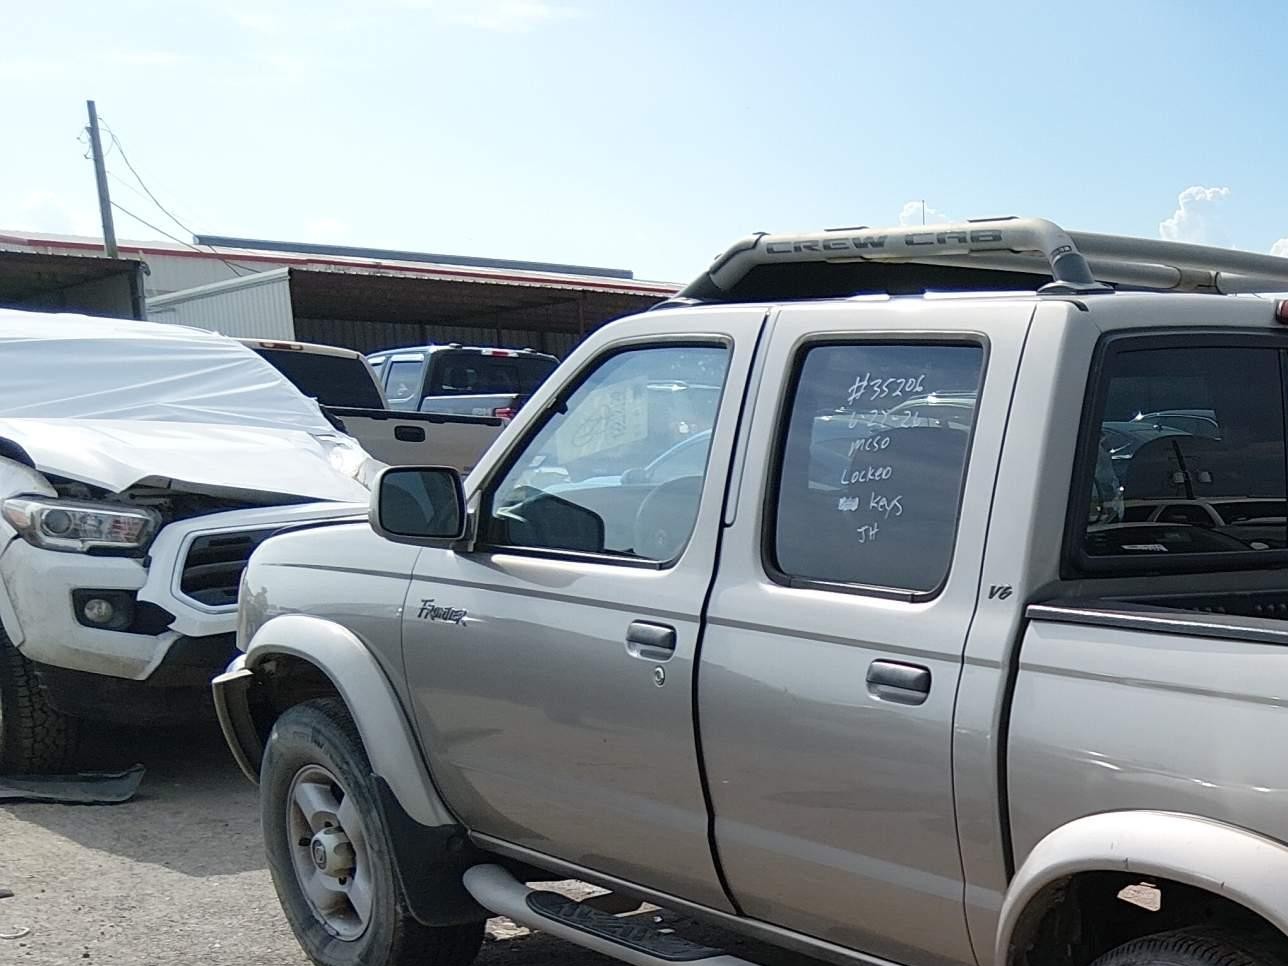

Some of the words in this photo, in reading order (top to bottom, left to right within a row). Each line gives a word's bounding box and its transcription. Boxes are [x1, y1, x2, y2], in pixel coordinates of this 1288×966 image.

[766, 235, 888, 254] CREW
[905, 229, 1002, 246] CAB
[848, 372, 925, 405] #35206
[989, 585, 1013, 600] V6
